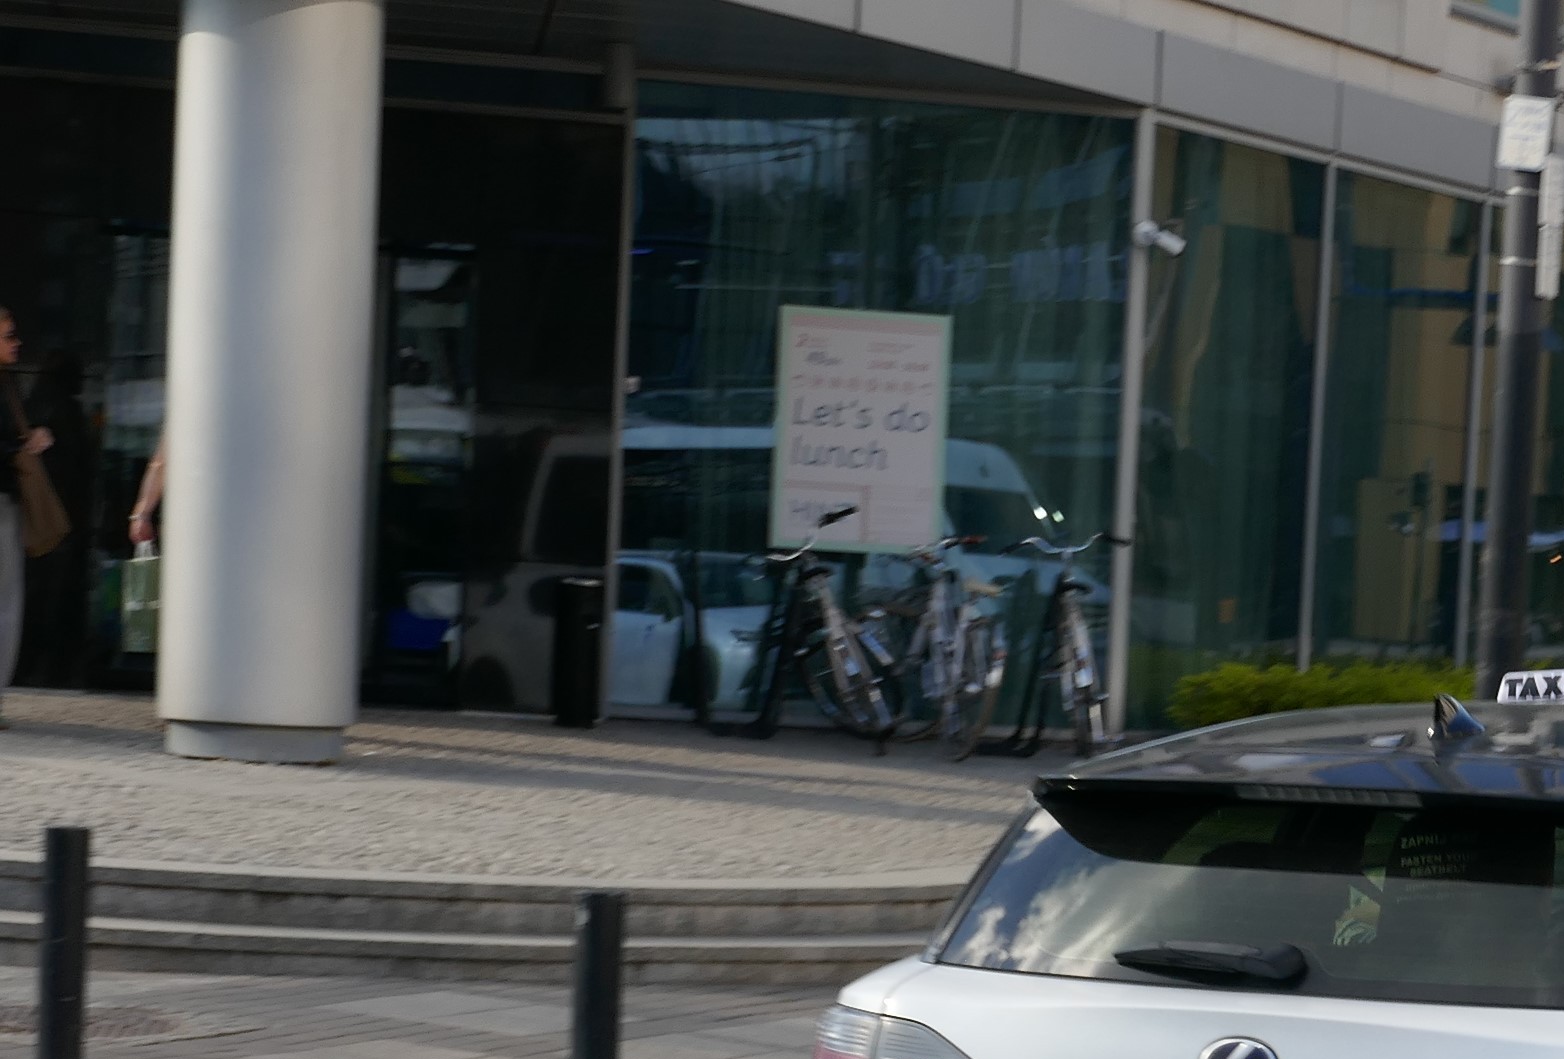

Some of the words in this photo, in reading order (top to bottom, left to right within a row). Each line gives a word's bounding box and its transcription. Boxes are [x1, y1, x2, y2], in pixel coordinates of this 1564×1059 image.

[792, 399, 872, 430] Let's
[882, 402, 931, 433] do
[790, 435, 888, 471] lunch
